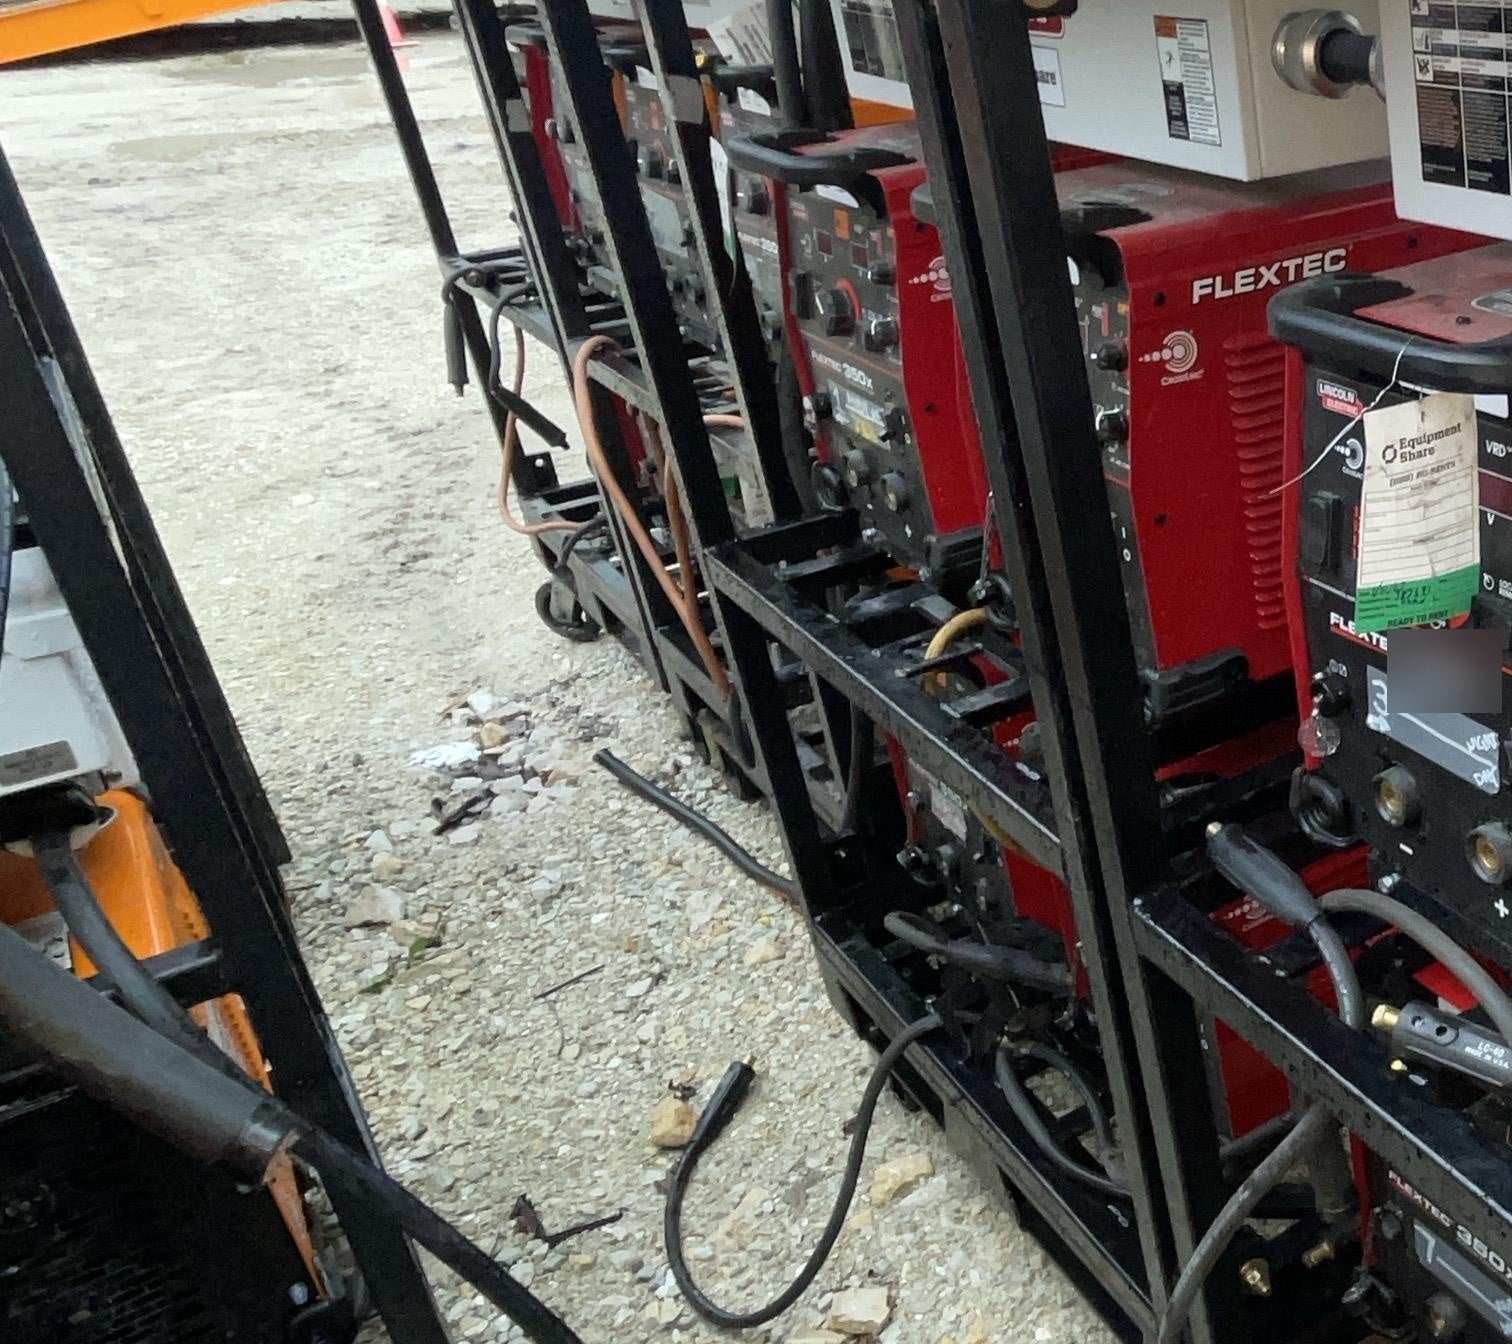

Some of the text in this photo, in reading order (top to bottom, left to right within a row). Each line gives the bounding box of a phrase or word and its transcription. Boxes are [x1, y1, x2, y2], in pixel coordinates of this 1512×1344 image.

[1192, 247, 1347, 305] FLEXTEC
[1319, 382, 1355, 404] LINCOLN
[1399, 422, 1462, 450] Equipment
[1399, 446, 1436, 464] Share
[1329, 611, 1389, 652] FLEXTE
